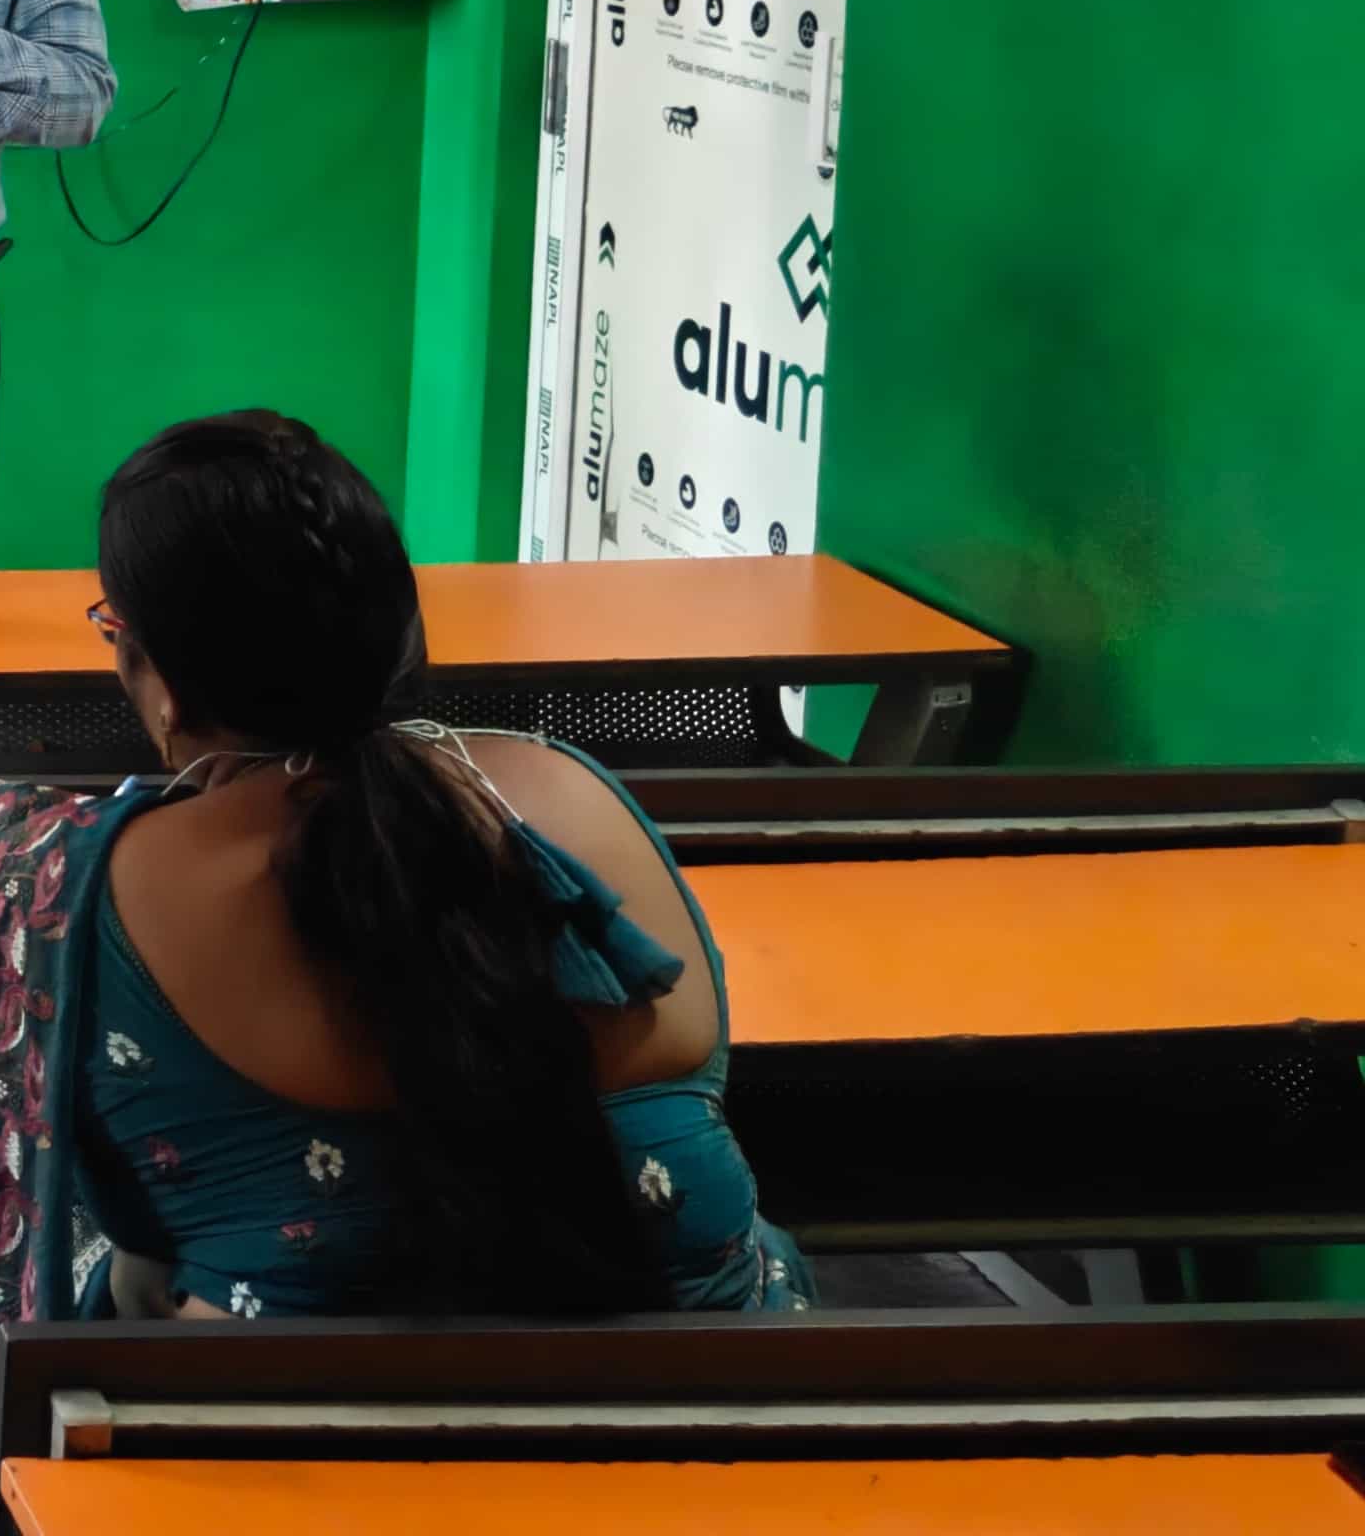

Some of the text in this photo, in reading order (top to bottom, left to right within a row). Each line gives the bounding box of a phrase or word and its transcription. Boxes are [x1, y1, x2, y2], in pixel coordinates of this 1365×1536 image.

[546, 269, 558, 328] NAPL
[583, 310, 610, 502] alumaze
[540, 419, 550, 476] NAPL
